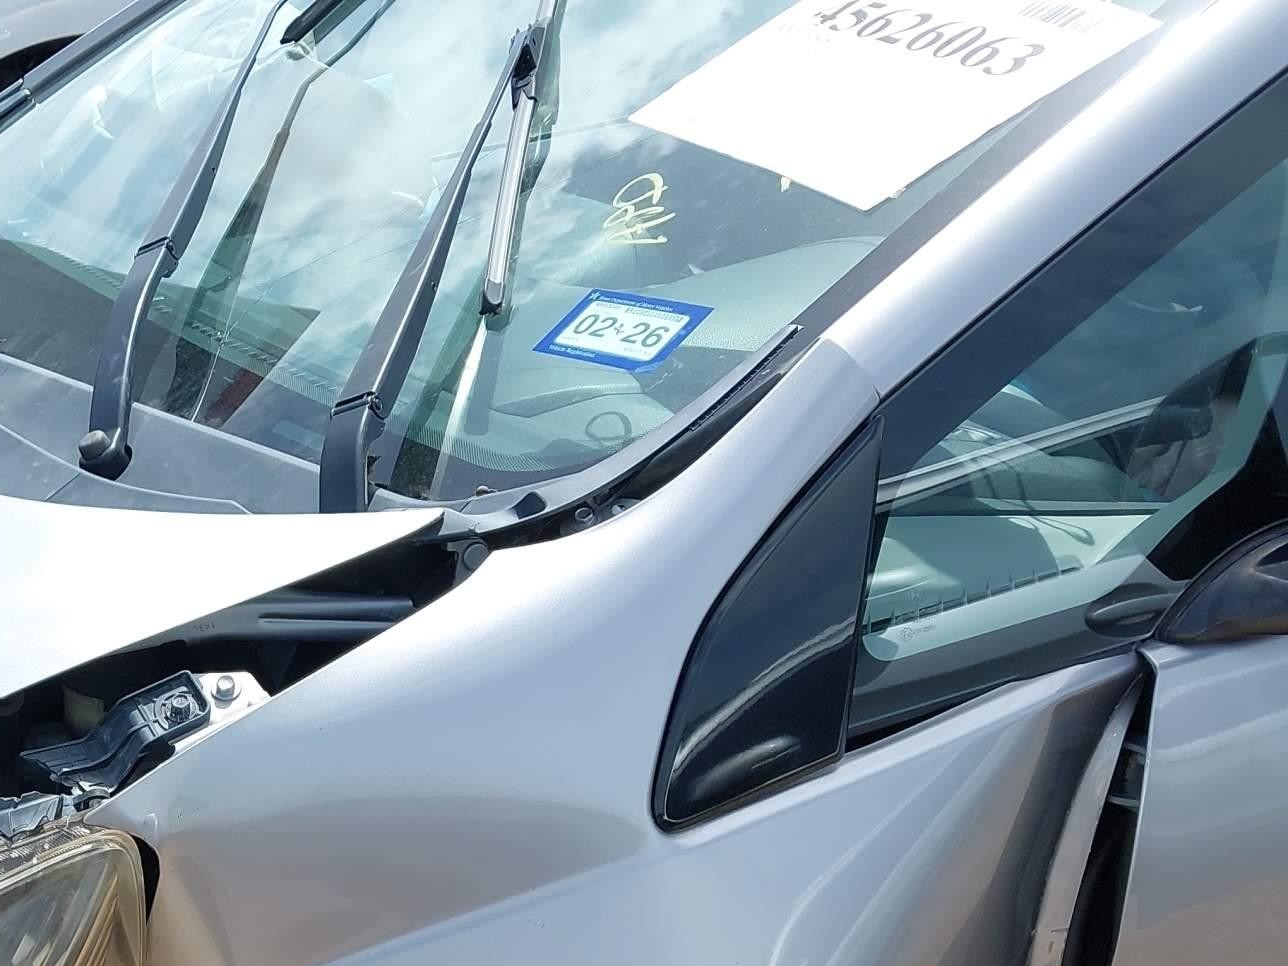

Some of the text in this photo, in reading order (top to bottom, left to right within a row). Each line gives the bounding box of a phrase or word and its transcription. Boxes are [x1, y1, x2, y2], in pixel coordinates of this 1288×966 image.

[813, 0, 1046, 76] 45626063
[572, 313, 618, 338] 02
[619, 321, 670, 348] 26
